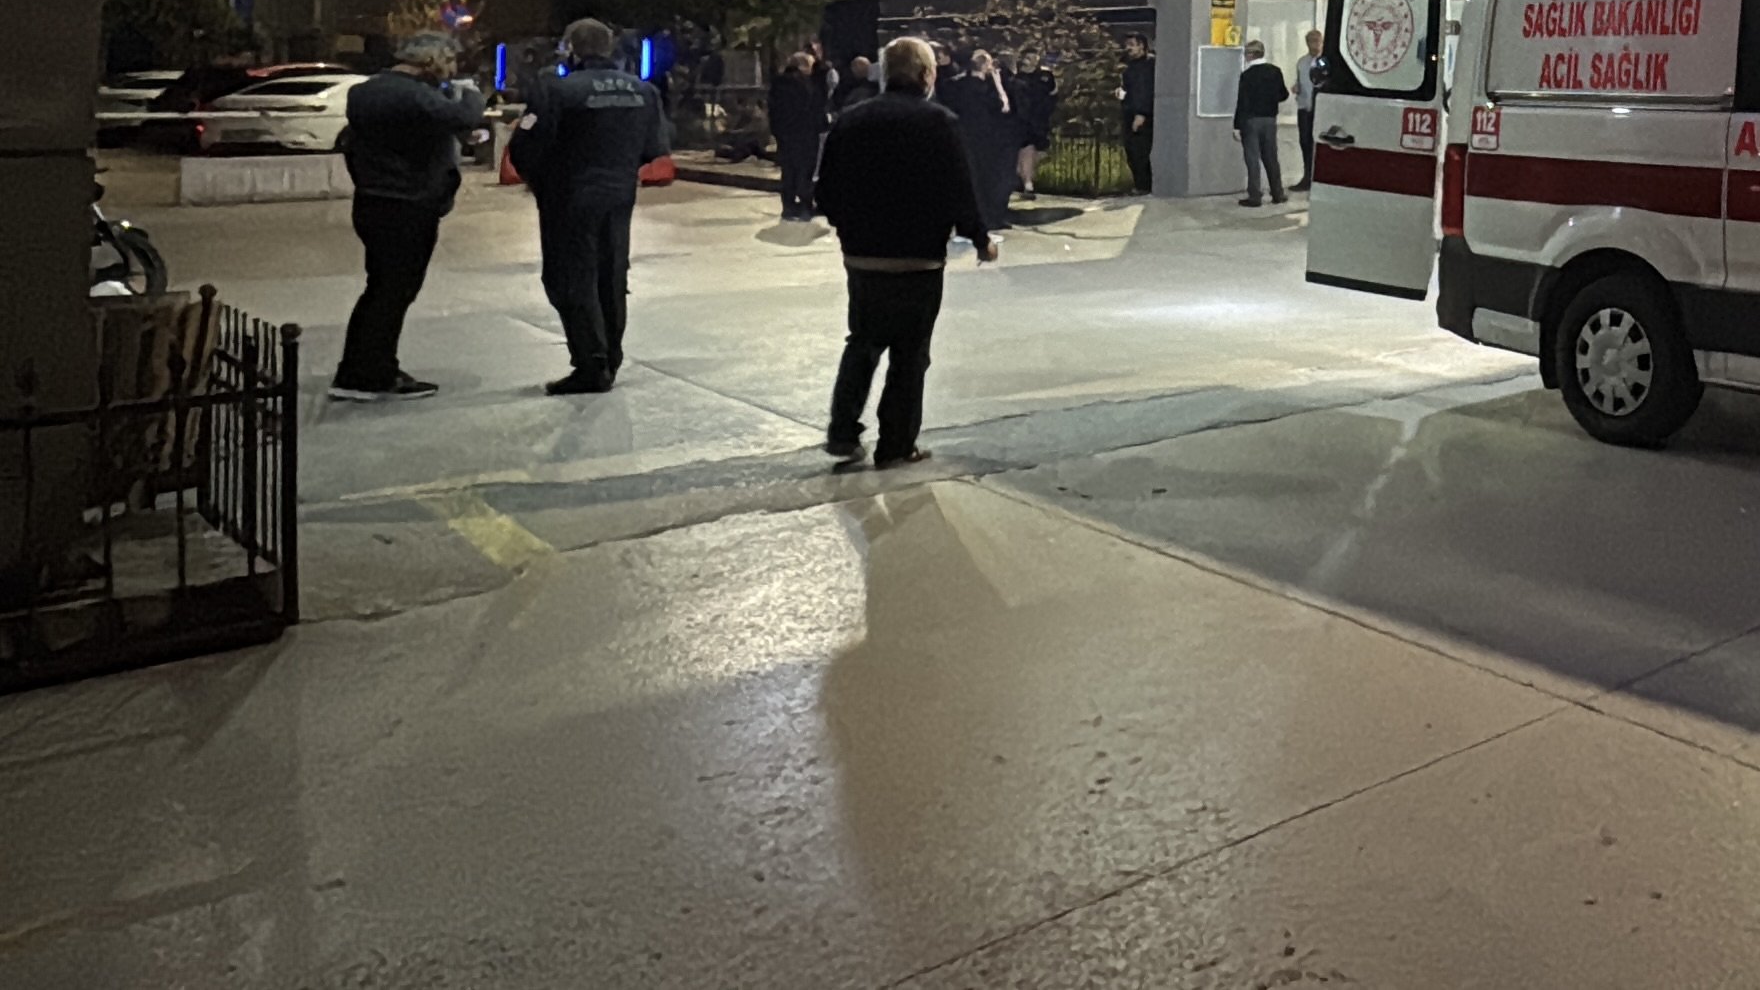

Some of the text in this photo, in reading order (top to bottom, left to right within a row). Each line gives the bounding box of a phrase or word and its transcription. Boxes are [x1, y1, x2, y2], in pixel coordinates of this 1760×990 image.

[1539, 42, 1669, 92] ACİL SAĞLIK
[1407, 112, 1432, 134] 112
[1475, 110, 1497, 133] 112
